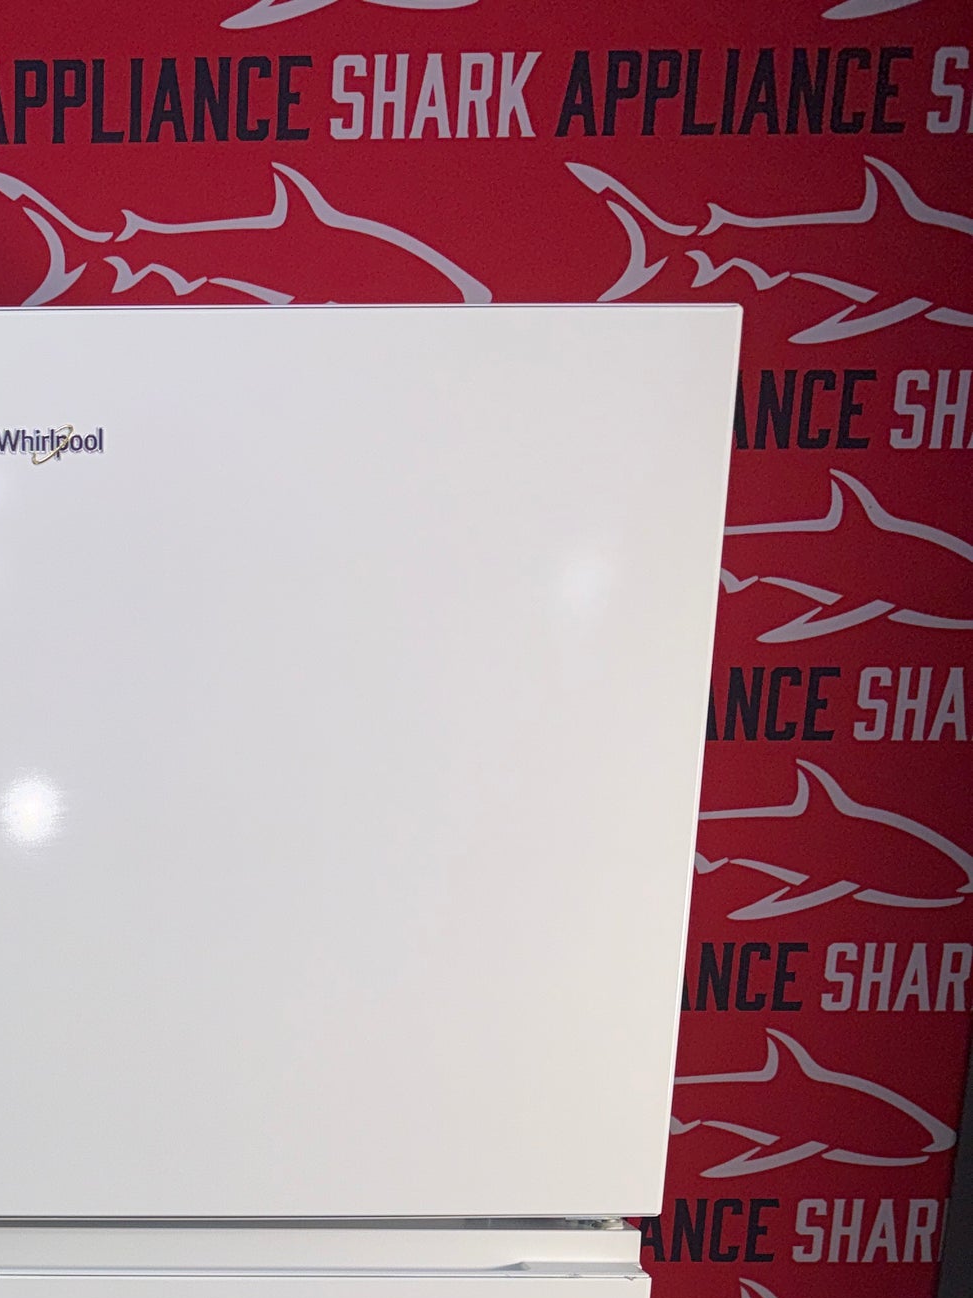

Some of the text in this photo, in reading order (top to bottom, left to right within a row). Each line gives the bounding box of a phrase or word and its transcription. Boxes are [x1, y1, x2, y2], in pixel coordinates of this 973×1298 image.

[329, 51, 542, 141] SHARK
[555, 46, 914, 137] APPLIANCE
[927, 46, 973, 134] S
[890, 369, 973, 449] SH
[681, 942, 973, 1012] NCE SHAR
[792, 1198, 949, 1263] SHAR
